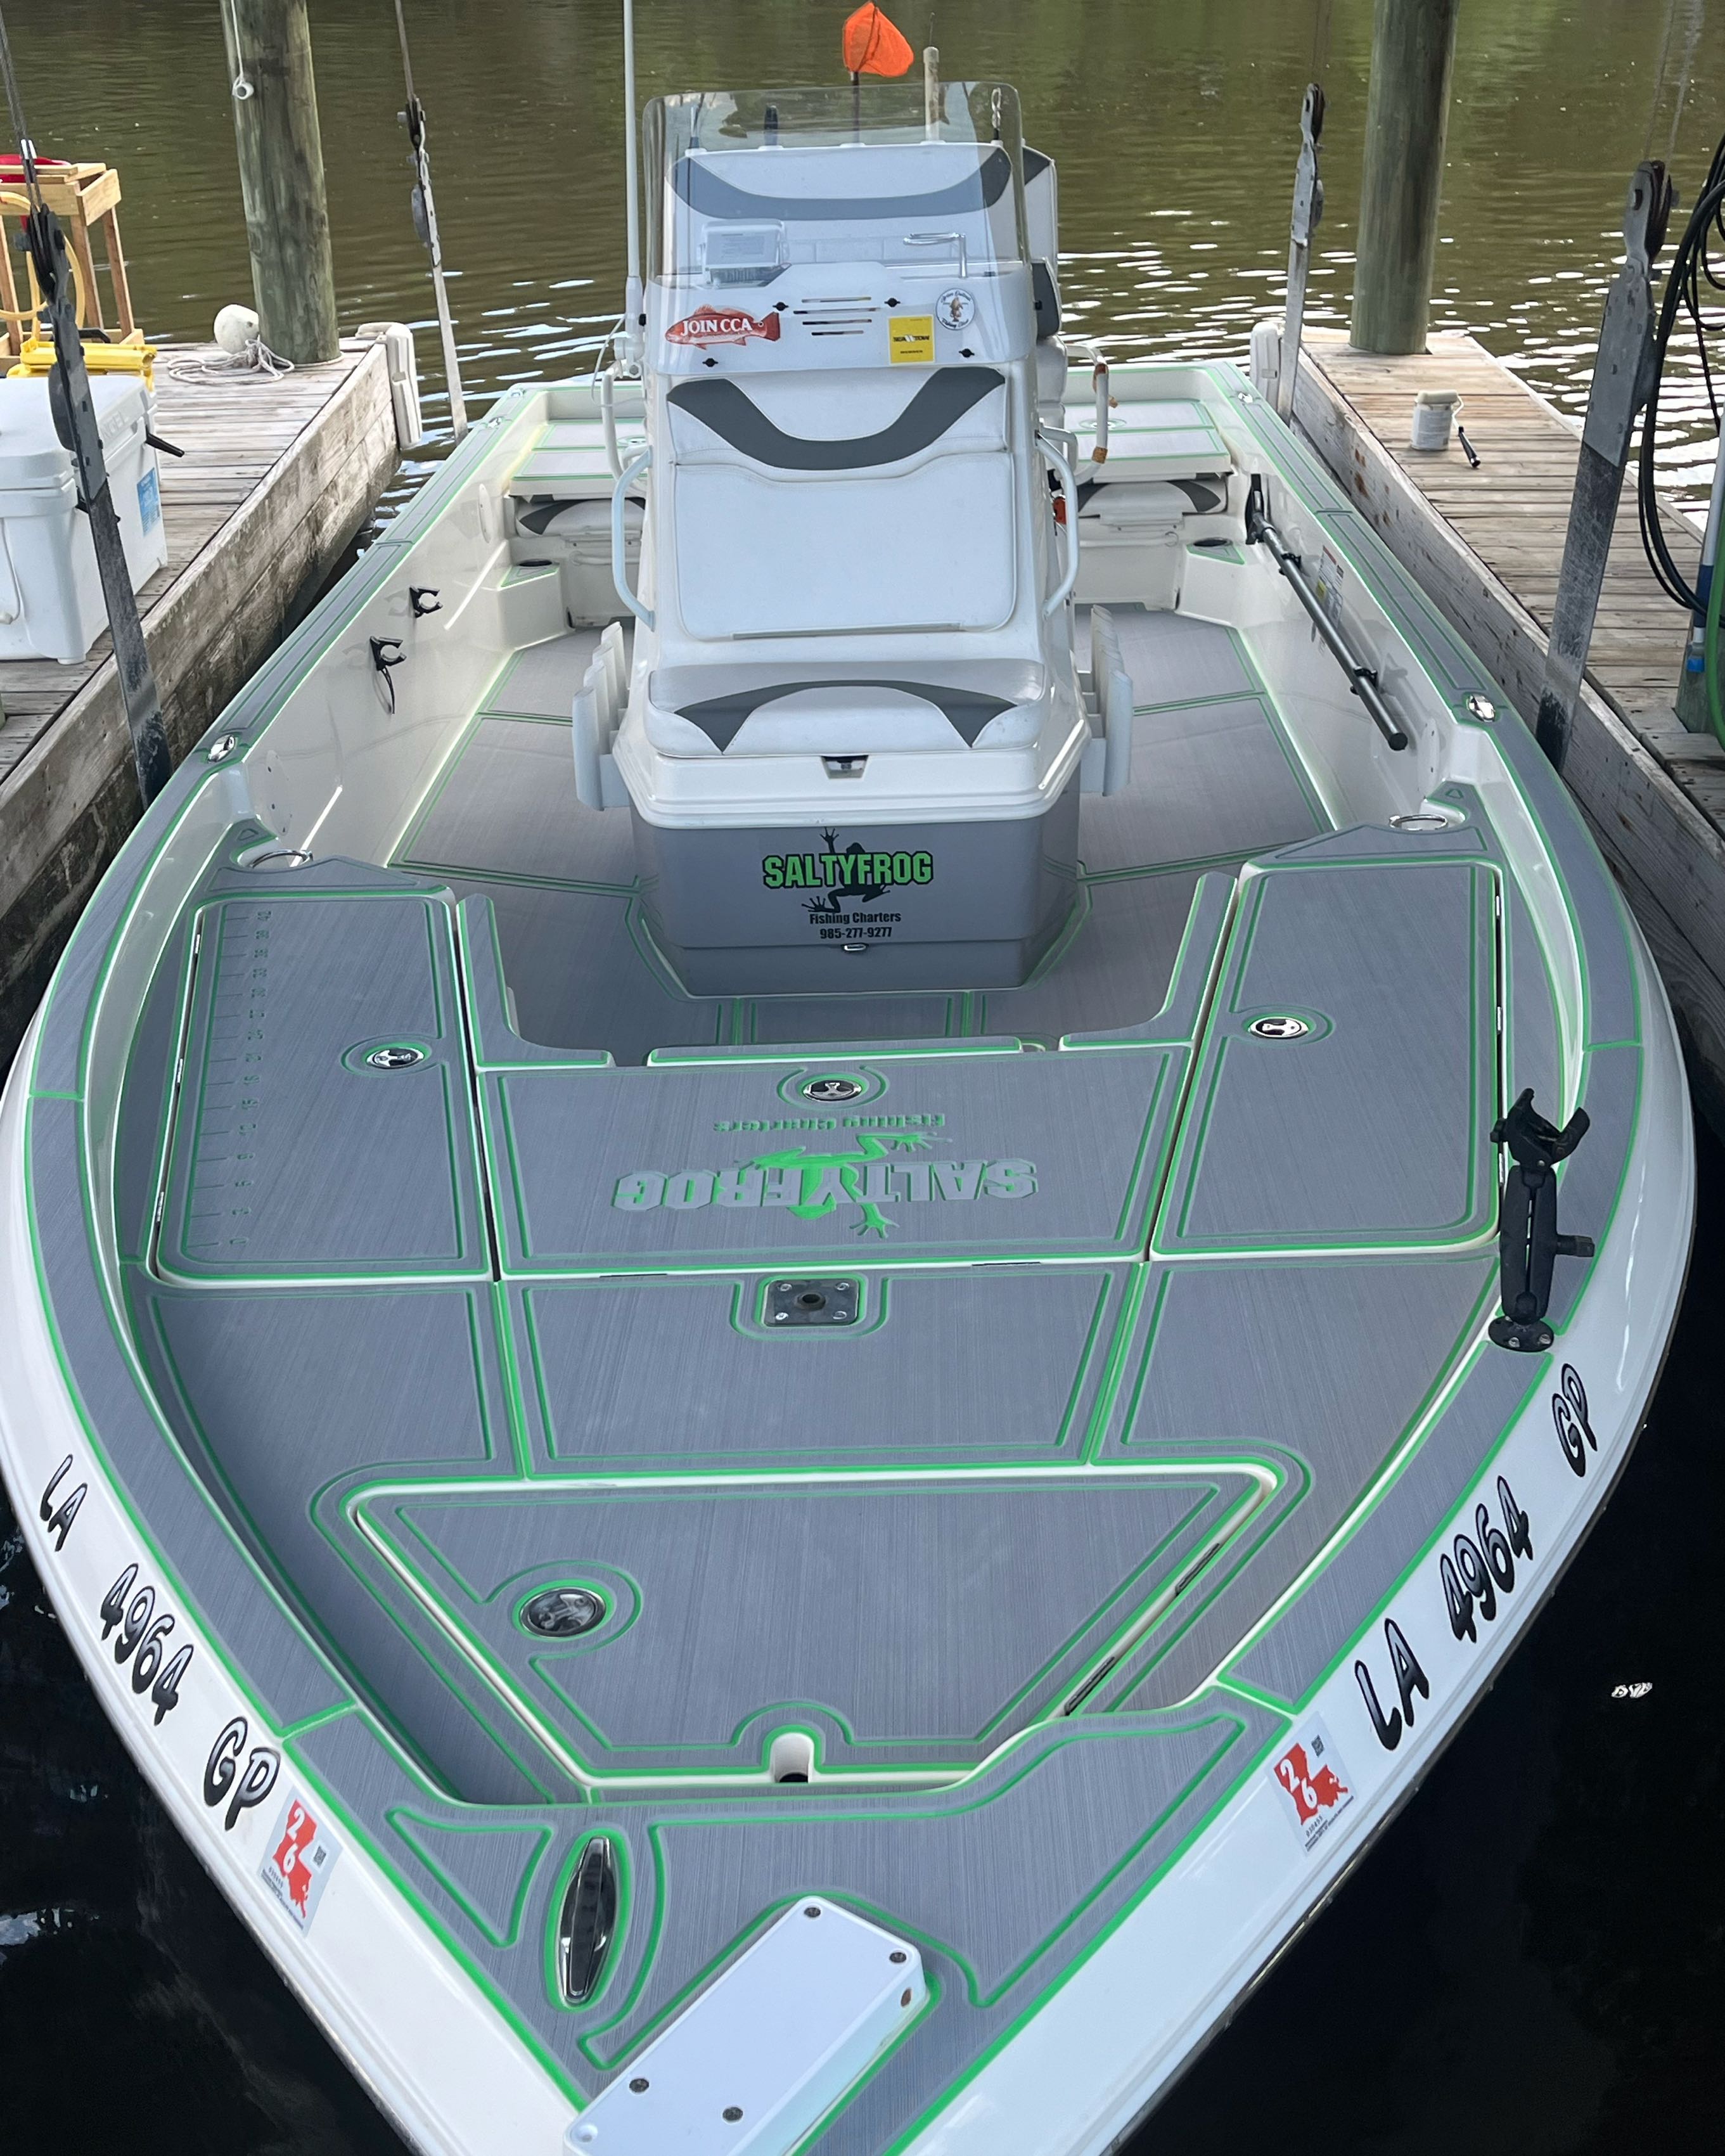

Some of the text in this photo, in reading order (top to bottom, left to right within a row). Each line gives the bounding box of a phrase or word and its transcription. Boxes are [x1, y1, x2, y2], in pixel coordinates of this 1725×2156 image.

[681, 318, 753, 337] JOIN CCA
[763, 850, 933, 889] SALTYFROG
[810, 912, 901, 925] Fishing Charters
[820, 927, 892, 939] 985-277-9277
[1354, 1363, 1597, 1751] LA 4964 GP
[40, 1454, 281, 1831] LA 4964 GP
